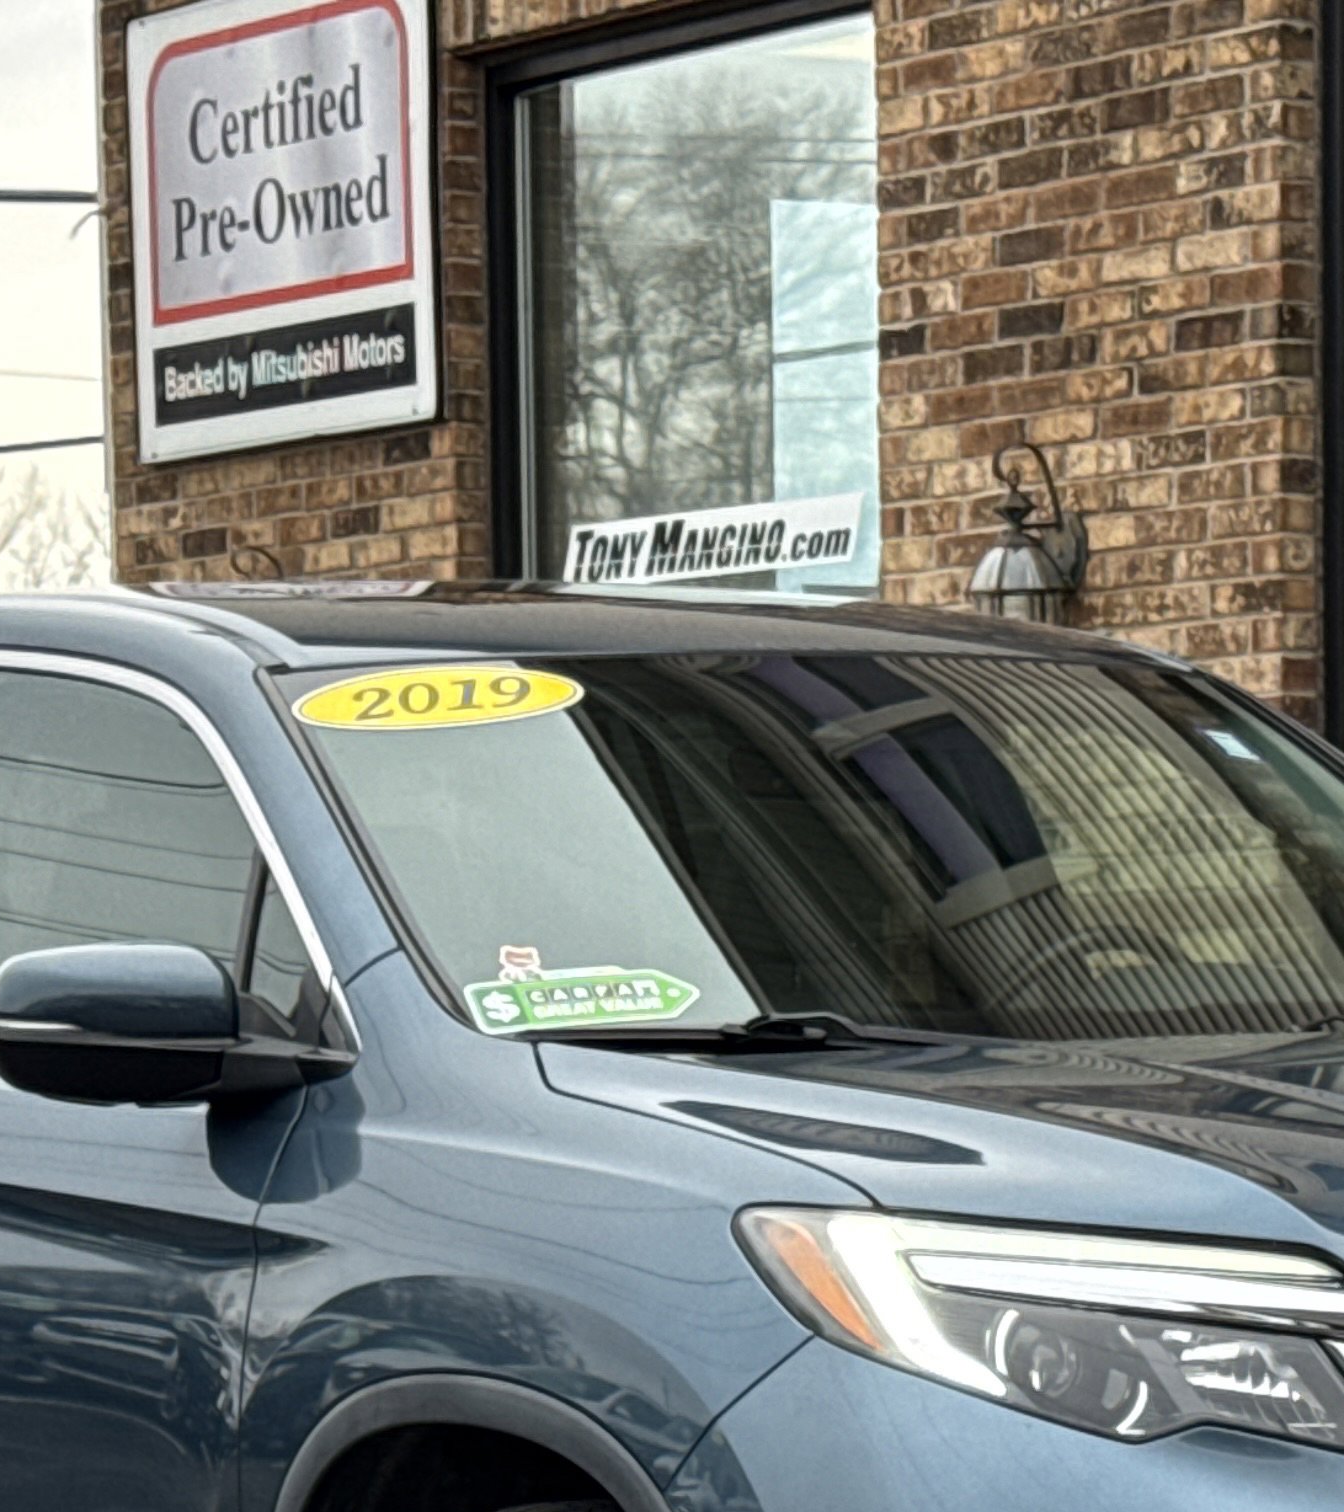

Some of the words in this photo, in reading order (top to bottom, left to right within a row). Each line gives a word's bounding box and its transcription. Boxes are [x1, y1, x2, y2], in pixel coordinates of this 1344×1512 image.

[188, 63, 364, 165] Certified
[172, 153, 391, 262] Pre-Owned
[164, 358, 225, 401] Backed
[226, 354, 249, 400] by
[251, 337, 340, 387] Mitsubishi
[343, 331, 406, 366] Motors
[352, 676, 532, 722] 2019
